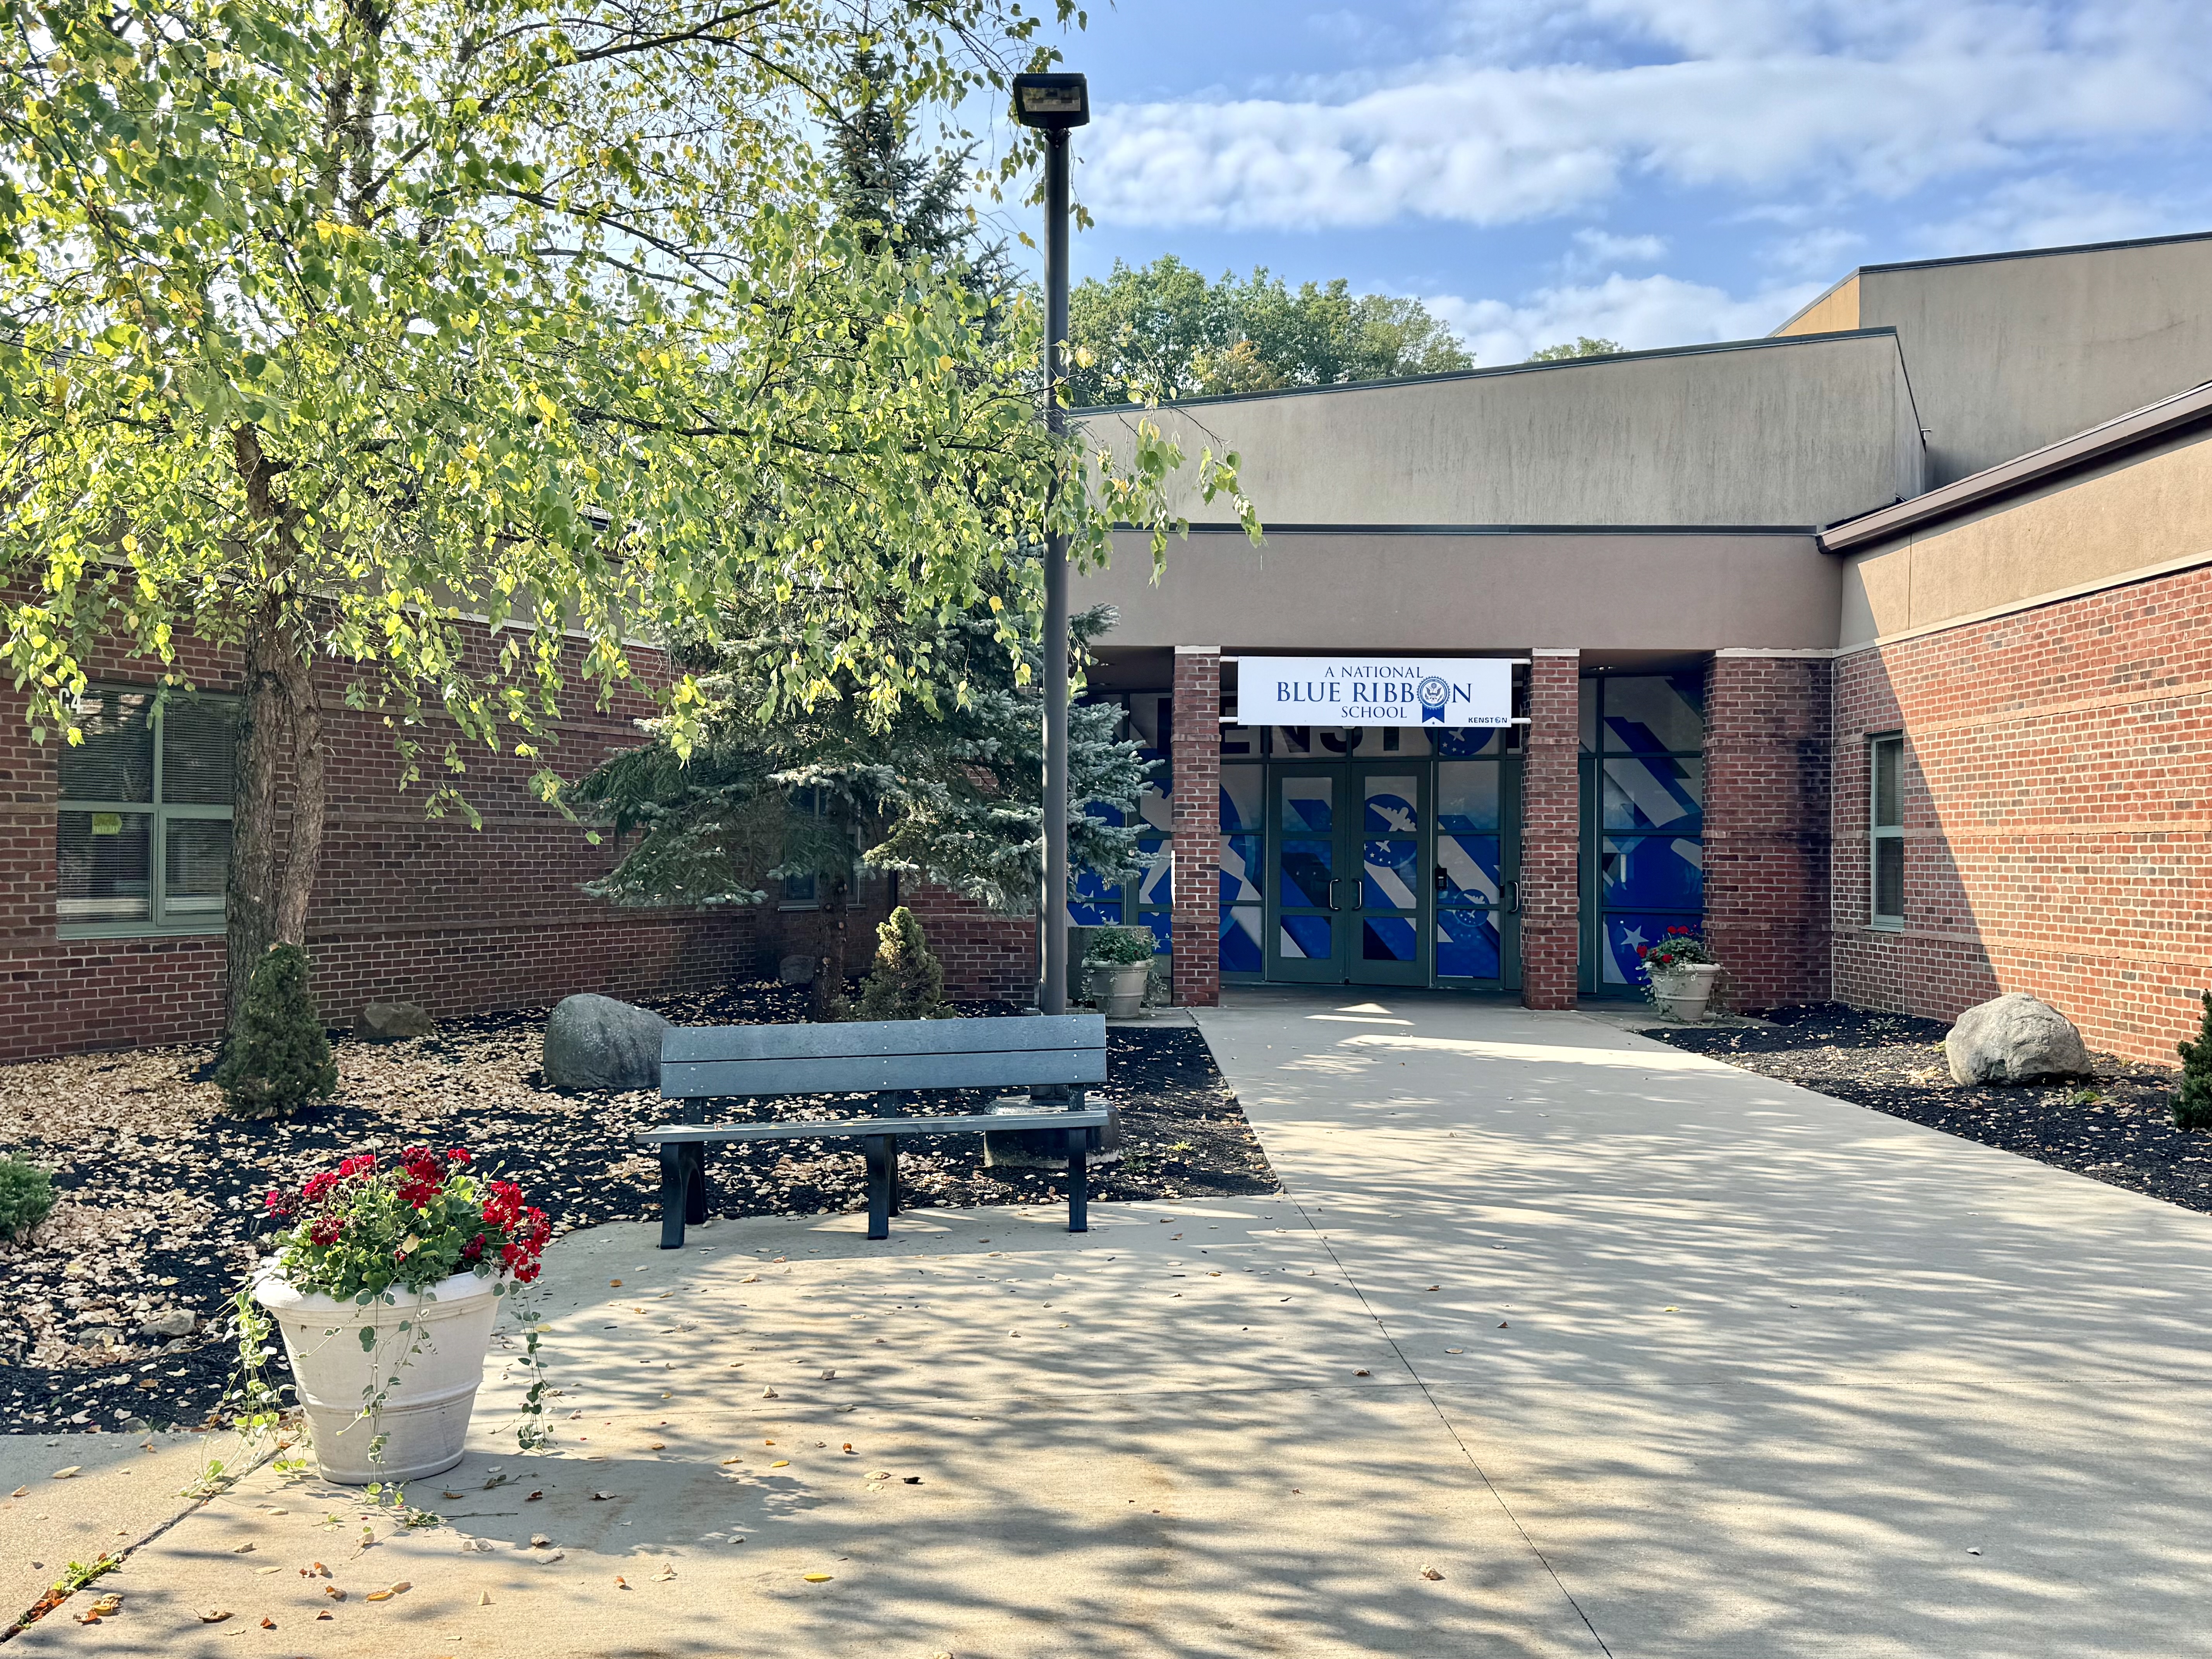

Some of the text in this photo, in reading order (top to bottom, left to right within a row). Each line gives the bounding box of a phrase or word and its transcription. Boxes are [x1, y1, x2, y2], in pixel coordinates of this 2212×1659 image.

[1325, 666, 1424, 678] A NATIONAL
[1277, 682, 1341, 702] BLUE
[58, 687, 81, 714] C4
[1341, 706, 1407, 718] SCHOOL
